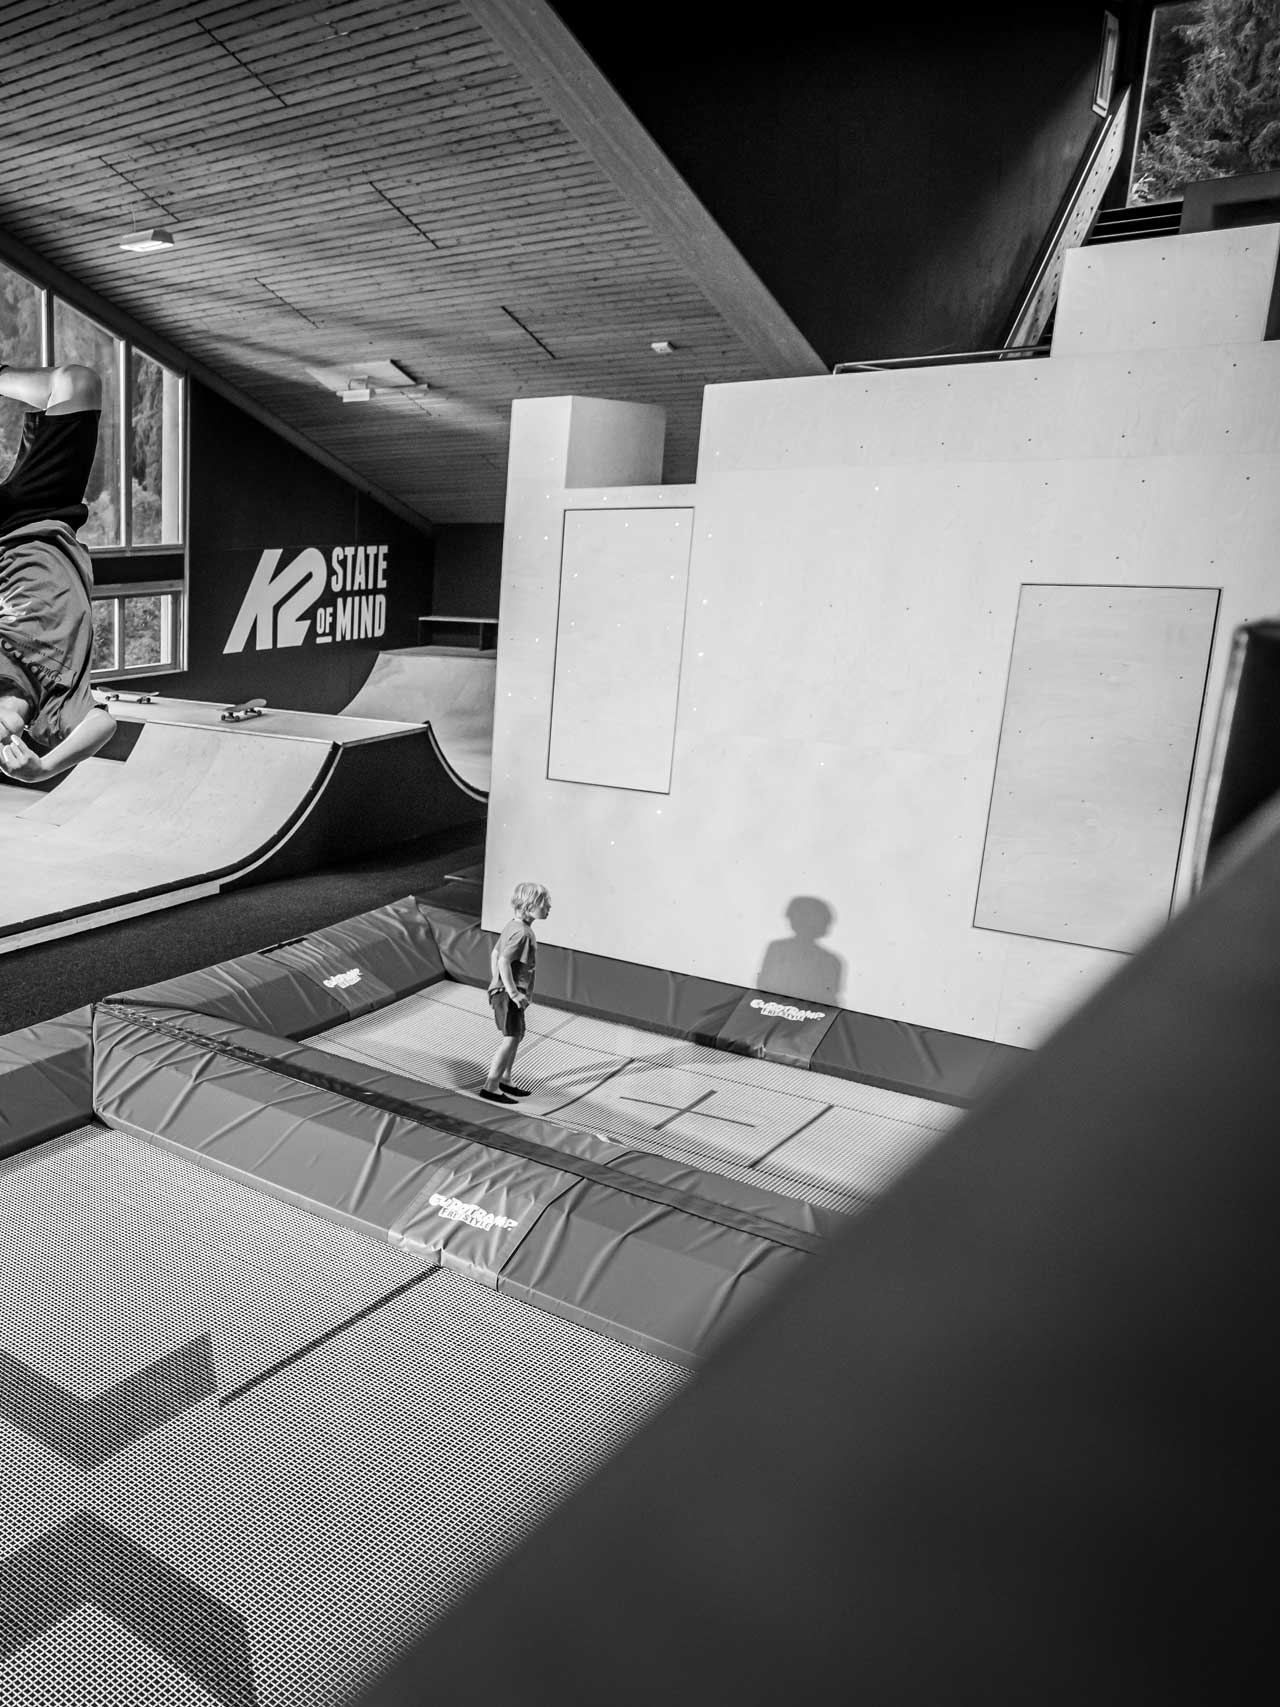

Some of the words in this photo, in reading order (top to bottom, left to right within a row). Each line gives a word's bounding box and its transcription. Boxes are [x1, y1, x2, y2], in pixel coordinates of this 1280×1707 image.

[331, 545, 389, 592] STATE
[223, 547, 327, 654] K2
[316, 606, 334, 635] OF
[336, 594, 387, 642] MIND
[439, 1207, 491, 1231] FRESTYLE
